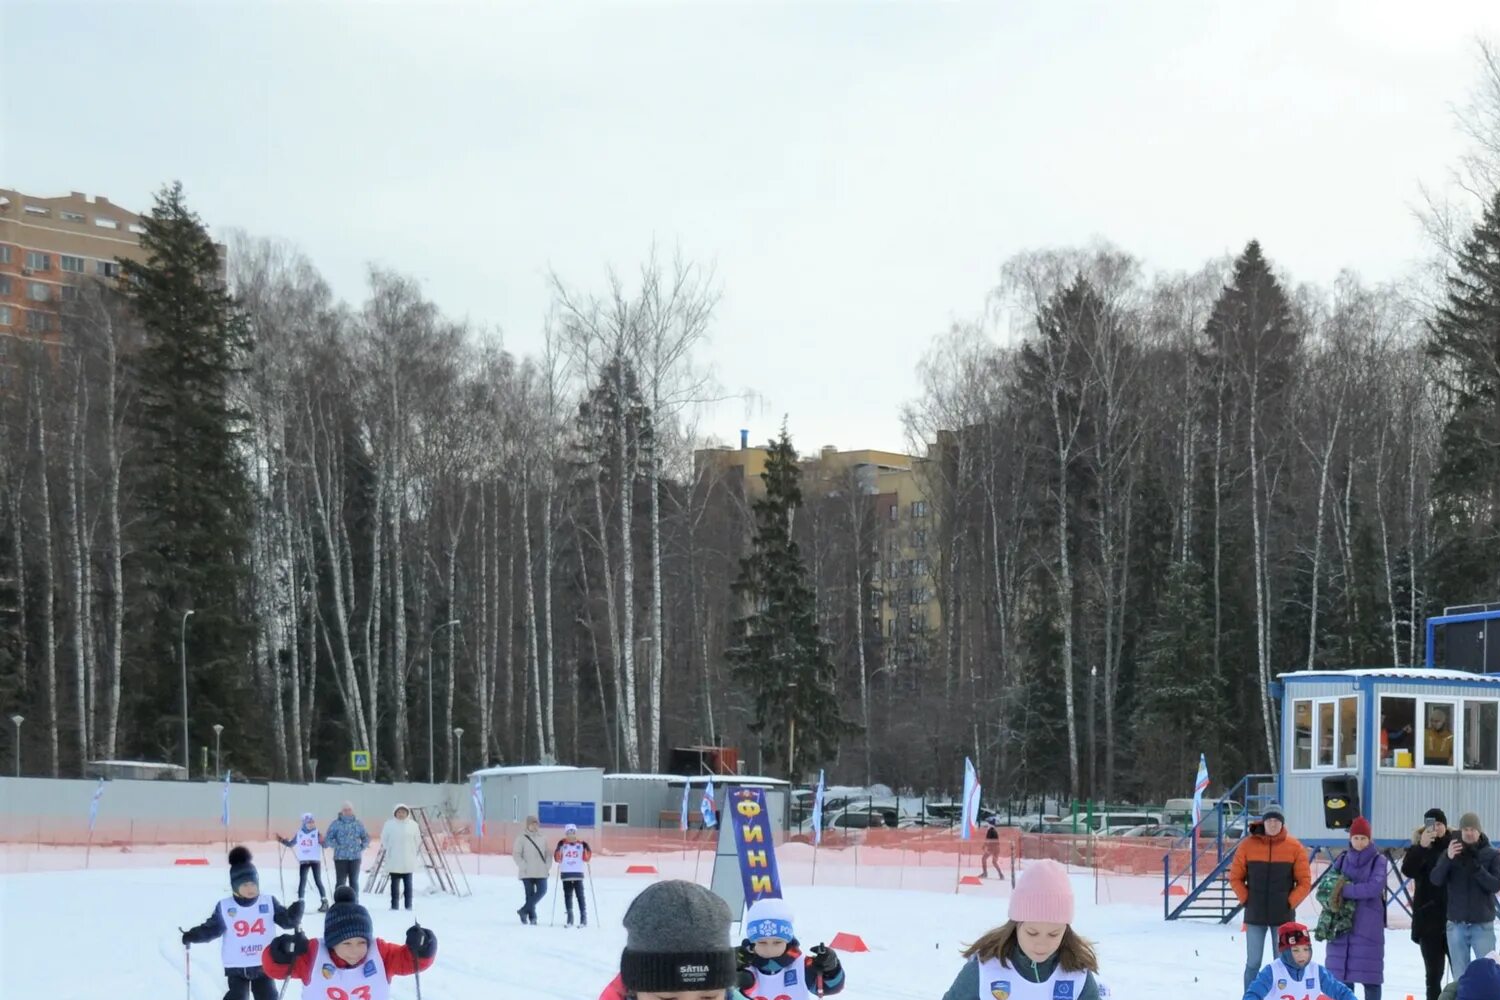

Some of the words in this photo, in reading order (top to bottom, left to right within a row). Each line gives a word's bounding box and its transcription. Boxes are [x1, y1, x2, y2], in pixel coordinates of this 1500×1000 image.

[300, 839, 313, 847] 43
[565, 850, 579, 858] 45
[736, 800, 773, 904] ФИНИ
[233, 918, 266, 937] 94
[680, 964, 710, 973] SÄTILA
